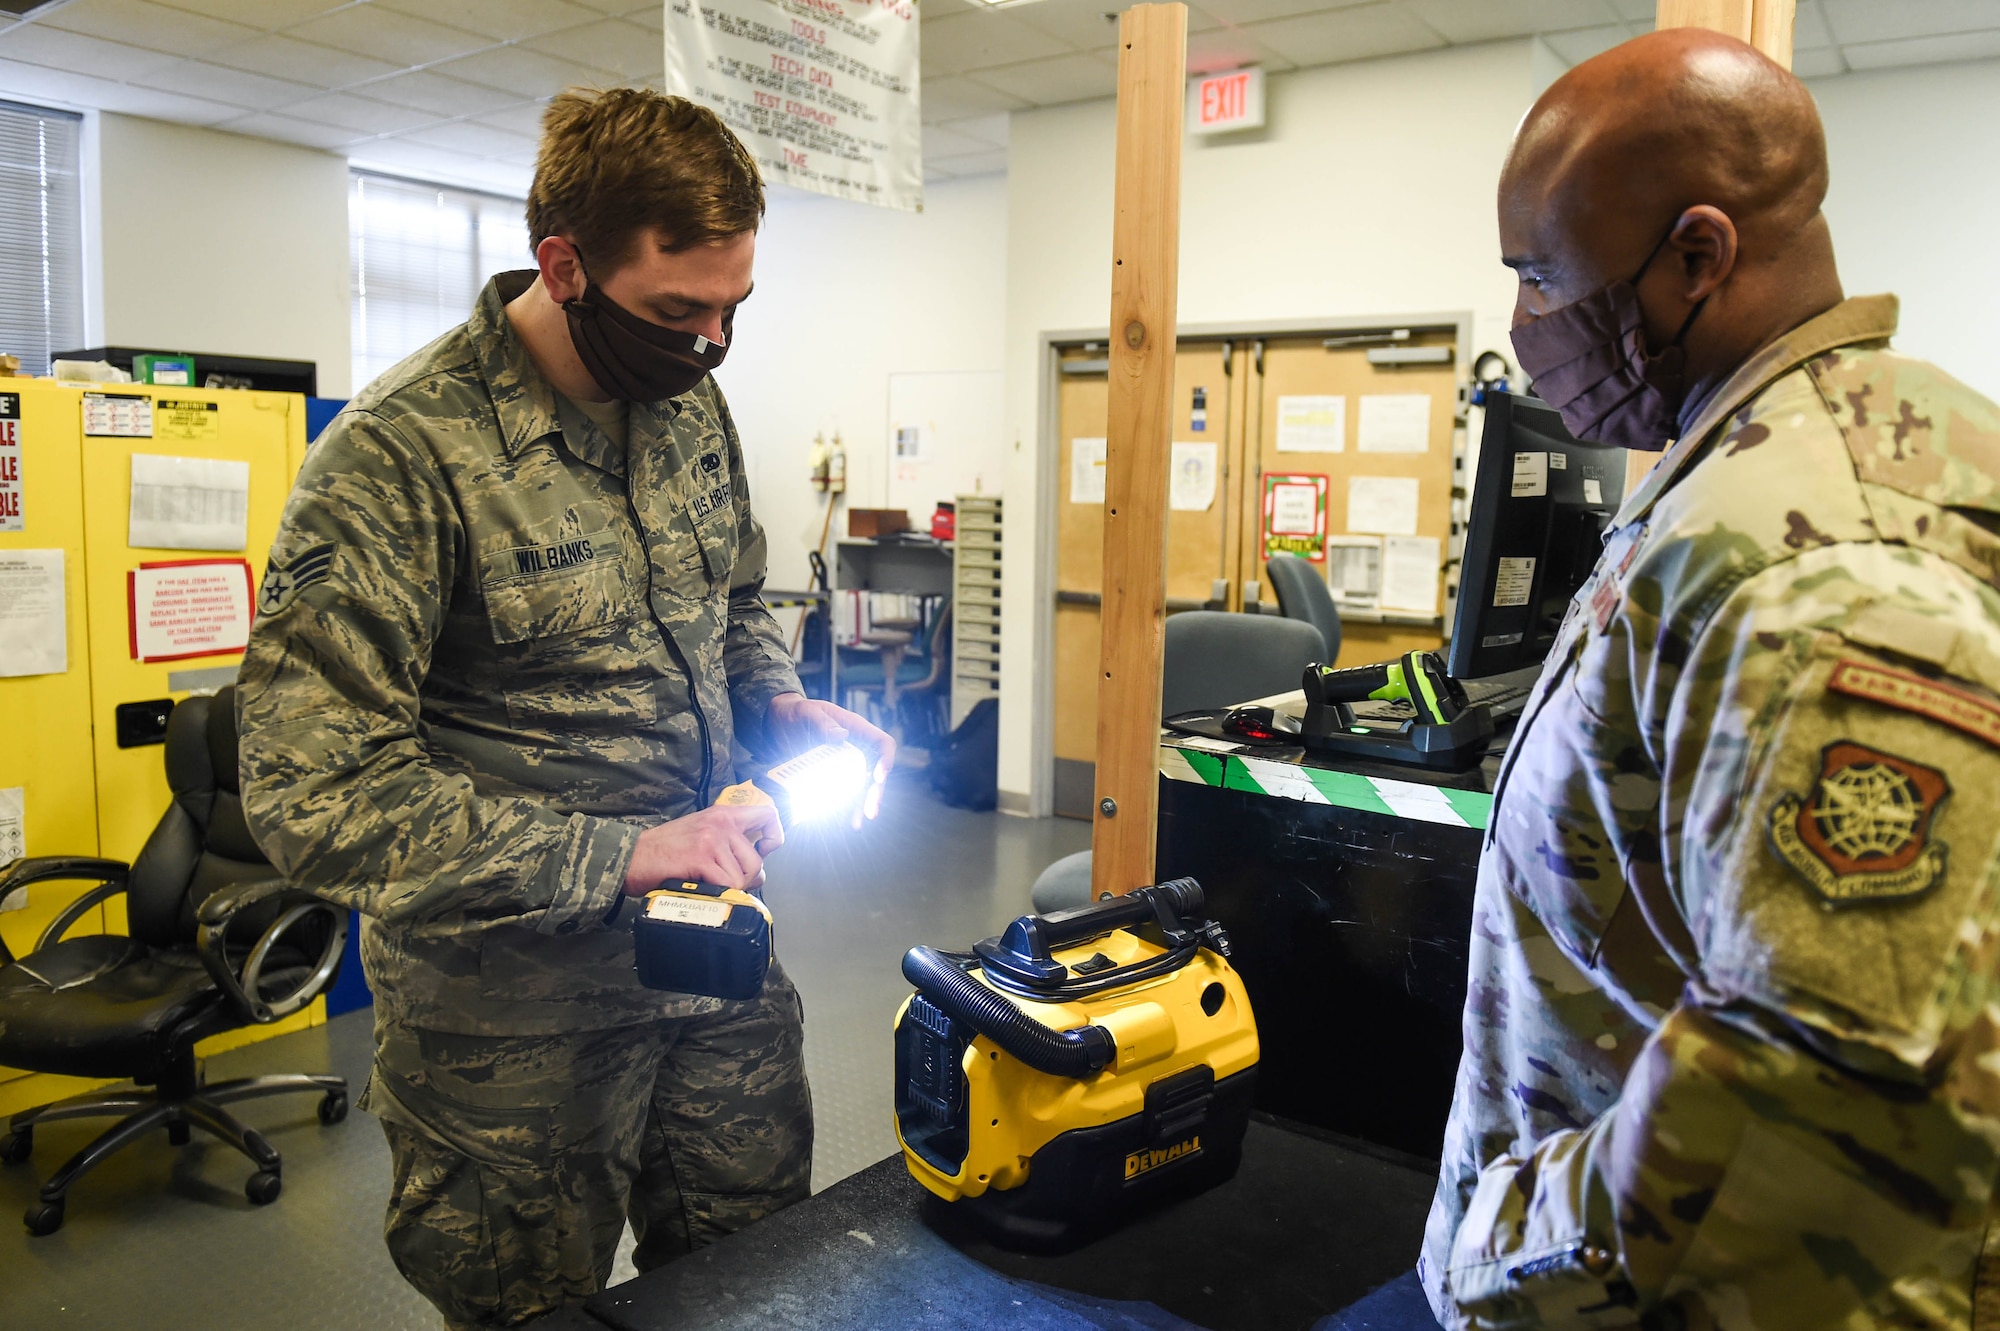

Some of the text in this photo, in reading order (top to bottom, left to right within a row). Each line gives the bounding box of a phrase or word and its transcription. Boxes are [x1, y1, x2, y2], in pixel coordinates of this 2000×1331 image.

[736, 16, 749, 28] THE
[791, 18, 826, 45] TOOLS
[727, 57, 741, 69] THE
[770, 53, 833, 88] TECH DATA
[753, 90, 837, 126] TEST EQUIPMENT
[1201, 73, 1250, 125] EXIT
[782, 146, 809, 169] TIME
[516, 539, 594, 573] WILBANKS
[155, 589, 183, 597] BARCODE
[150, 610, 176, 618] REPLACE
[169, 618, 196, 626] BARCODE
